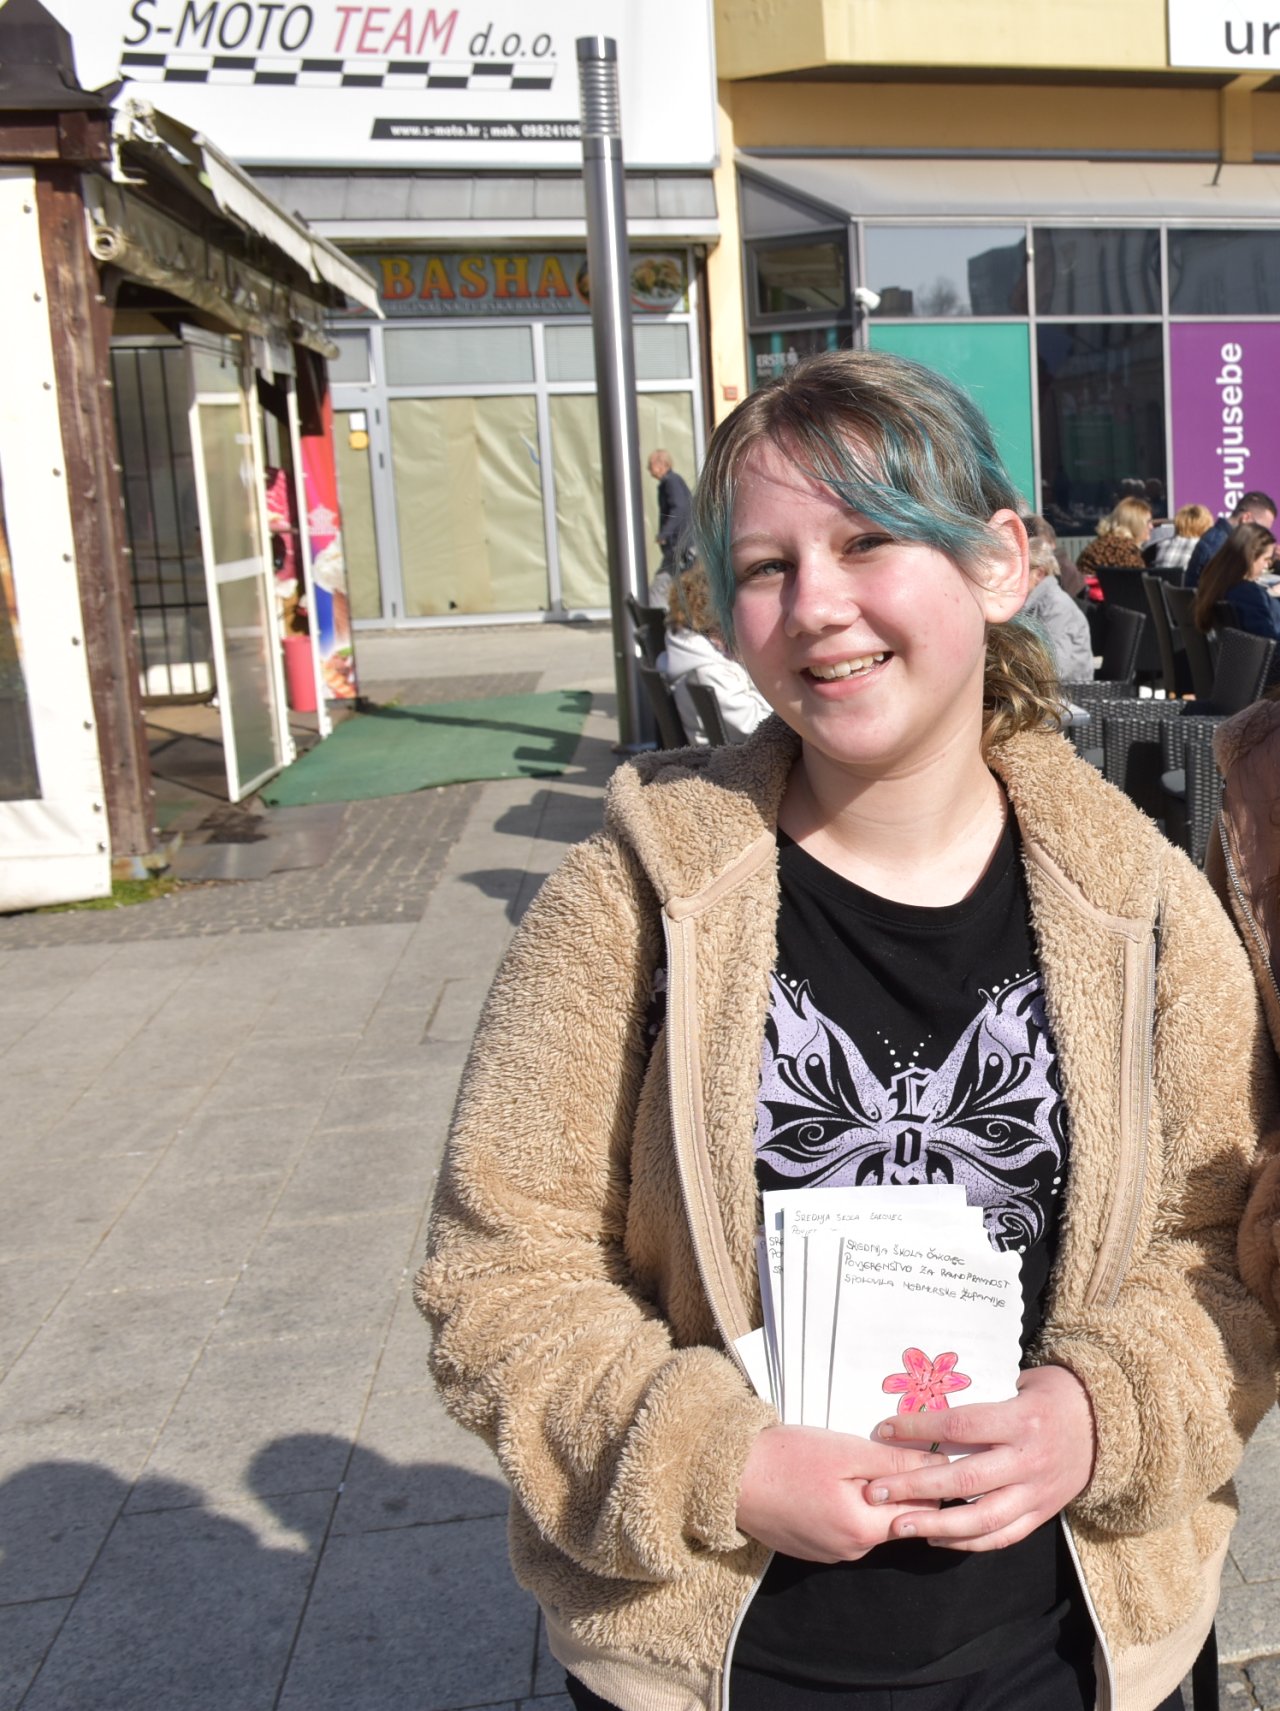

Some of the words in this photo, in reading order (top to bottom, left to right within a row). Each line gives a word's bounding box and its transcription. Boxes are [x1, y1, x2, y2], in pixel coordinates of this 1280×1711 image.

[122, 0, 314, 52] S-MOTO
[333, 6, 459, 56] TEAM
[468, 23, 557, 58] d.o.o.
[379, 256, 573, 299] BASHA
[846, 1239, 888, 1257] SREDNJA
[893, 1243, 923, 1258] ŠKOLA
